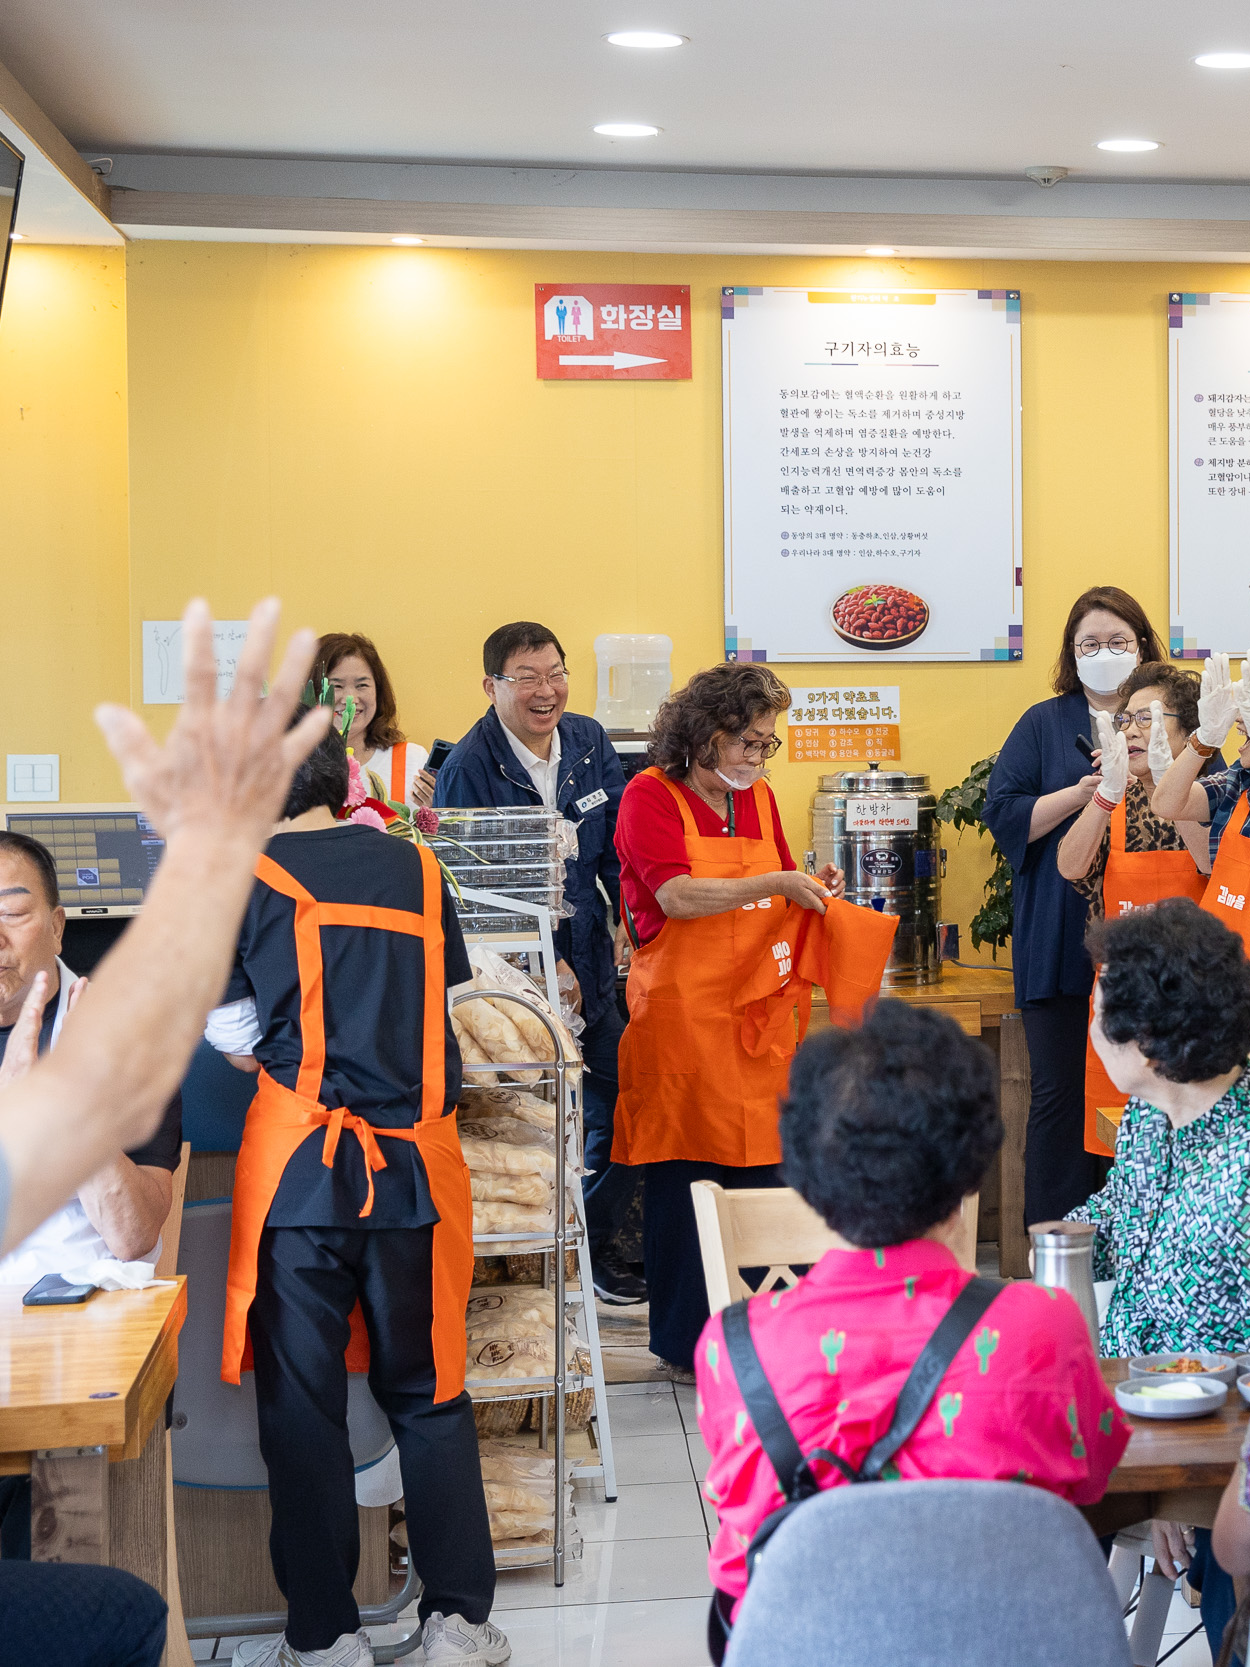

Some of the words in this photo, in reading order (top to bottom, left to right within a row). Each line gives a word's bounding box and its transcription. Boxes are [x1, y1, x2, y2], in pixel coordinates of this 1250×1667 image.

[600, 304, 682, 330] 화장실
[557, 335, 581, 343] TOILET
[824, 341, 921, 358] 구기자의효능
[780, 389, 840, 400] 동의보감에는
[845, 390, 894, 400] 혈액순환을
[899, 390, 938, 401] 원활하게
[942, 391, 961, 401] 하고
[780, 408, 810, 419] 혈관에
[848, 409, 877, 419] 독소를
[882, 409, 921, 419] 제거하며
[925, 410, 964, 420] 중성지방
[780, 427, 809, 438] 발생을
[859, 428, 908, 439] 염증질환을
[912, 428, 955, 439] 예방한다.
[780, 447, 820, 457] 간세포의
[824, 447, 854, 458] 손상을
[858, 447, 898, 458] 방지하여
[902, 448, 932, 458] 눈건강
[781, 466, 841, 477] 인지능력개선
[846, 466, 896, 477] 면역력증강
[898, 466, 929, 477] 몸안의
[932, 467, 961, 478] 독소를
[781, 485, 820, 496] 배출하고
[825, 485, 855, 496] 고혈압
[859, 486, 888, 496] 예방에
[893, 486, 911, 496] 많이
[916, 486, 945, 496] 도움이
[781, 505, 801, 515] 되는
[804, 504, 848, 515] 약재이다.
[807, 691, 840, 705] 9가지
[842, 690, 881, 704] 약초로
[792, 707, 828, 722] 정성껏
[831, 706, 897, 720] 다렸습니다.
[805, 728, 819, 737] 당귀
[839, 727, 860, 736] 하수오
[805, 739, 819, 748] 인삼
[839, 739, 854, 747] 감초
[1217, 885, 1245, 911] 감마을
